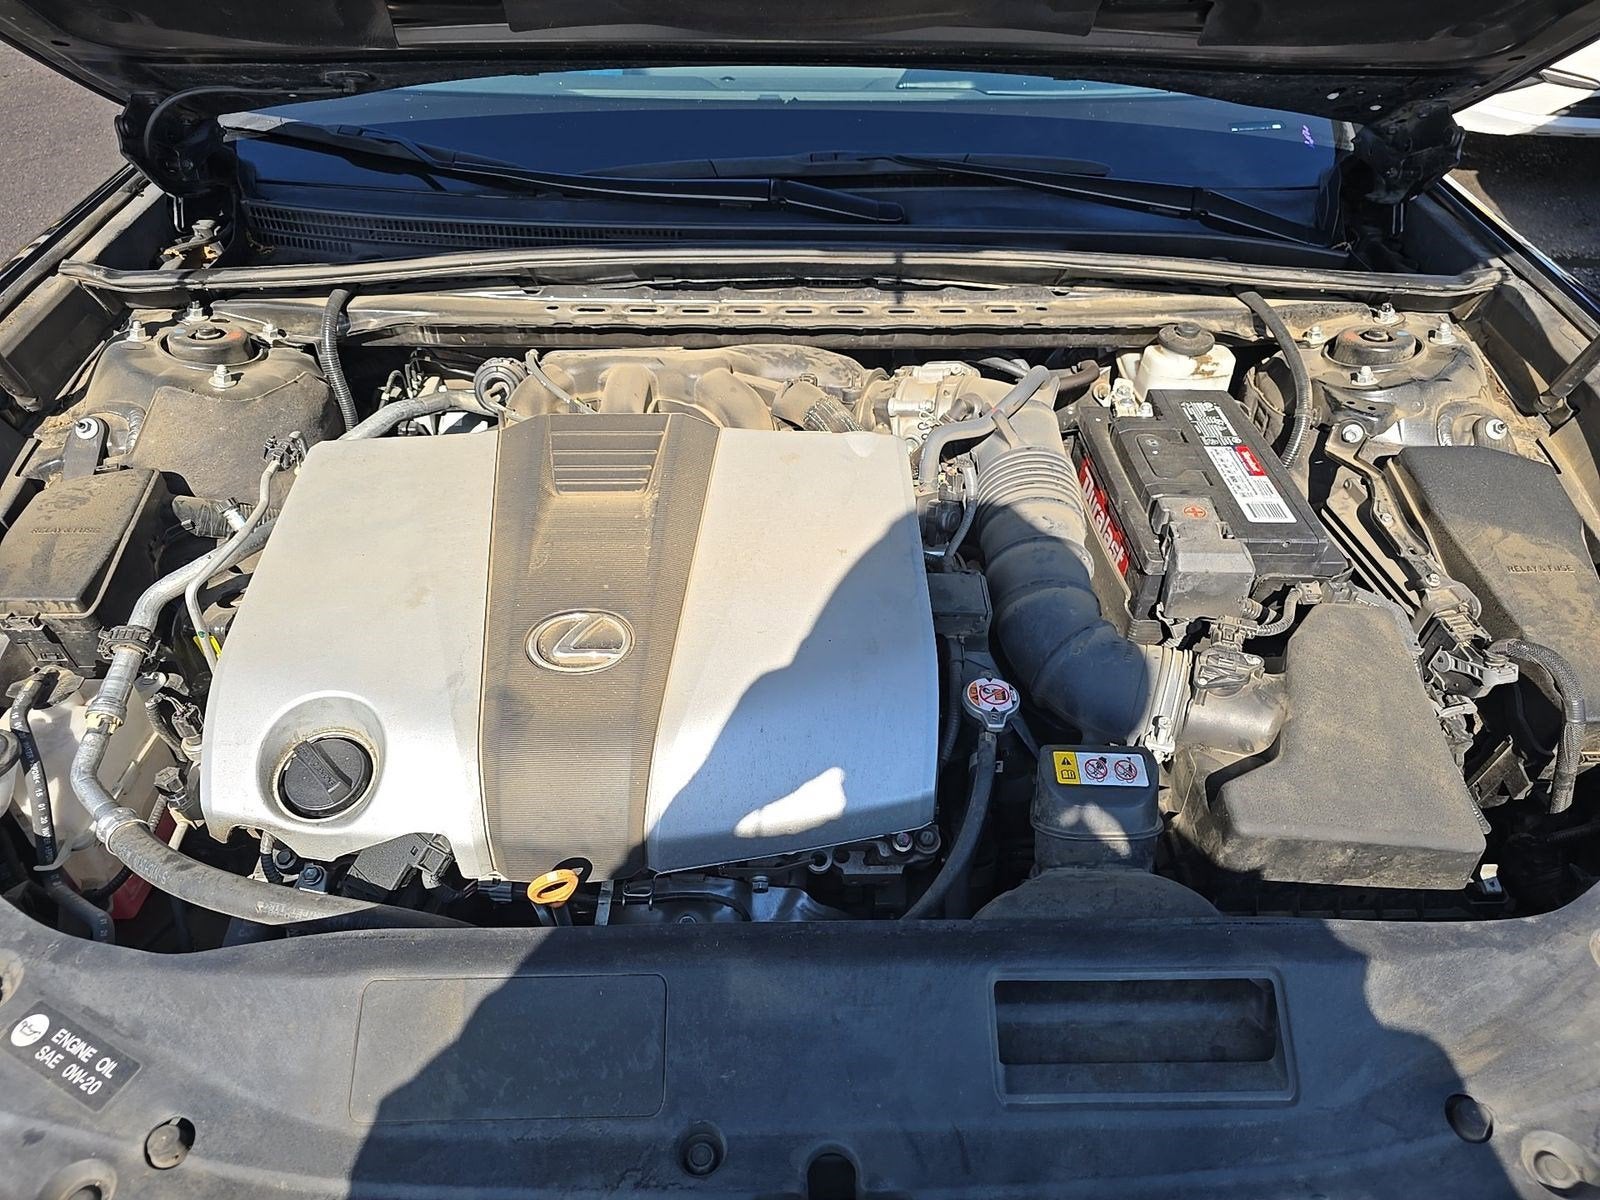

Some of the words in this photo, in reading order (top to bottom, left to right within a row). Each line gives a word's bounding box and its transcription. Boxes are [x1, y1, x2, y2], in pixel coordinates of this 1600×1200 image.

[1082, 465, 1125, 563] Duralast
[1507, 565, 1538, 573] RELAY
[1548, 565, 1575, 573] FUSE
[34, 1045, 65, 1070] SAE
[61, 1063, 103, 1095] 0W-20
[51, 1028, 98, 1063] ENGINE
[95, 1057, 119, 1079] OIL
